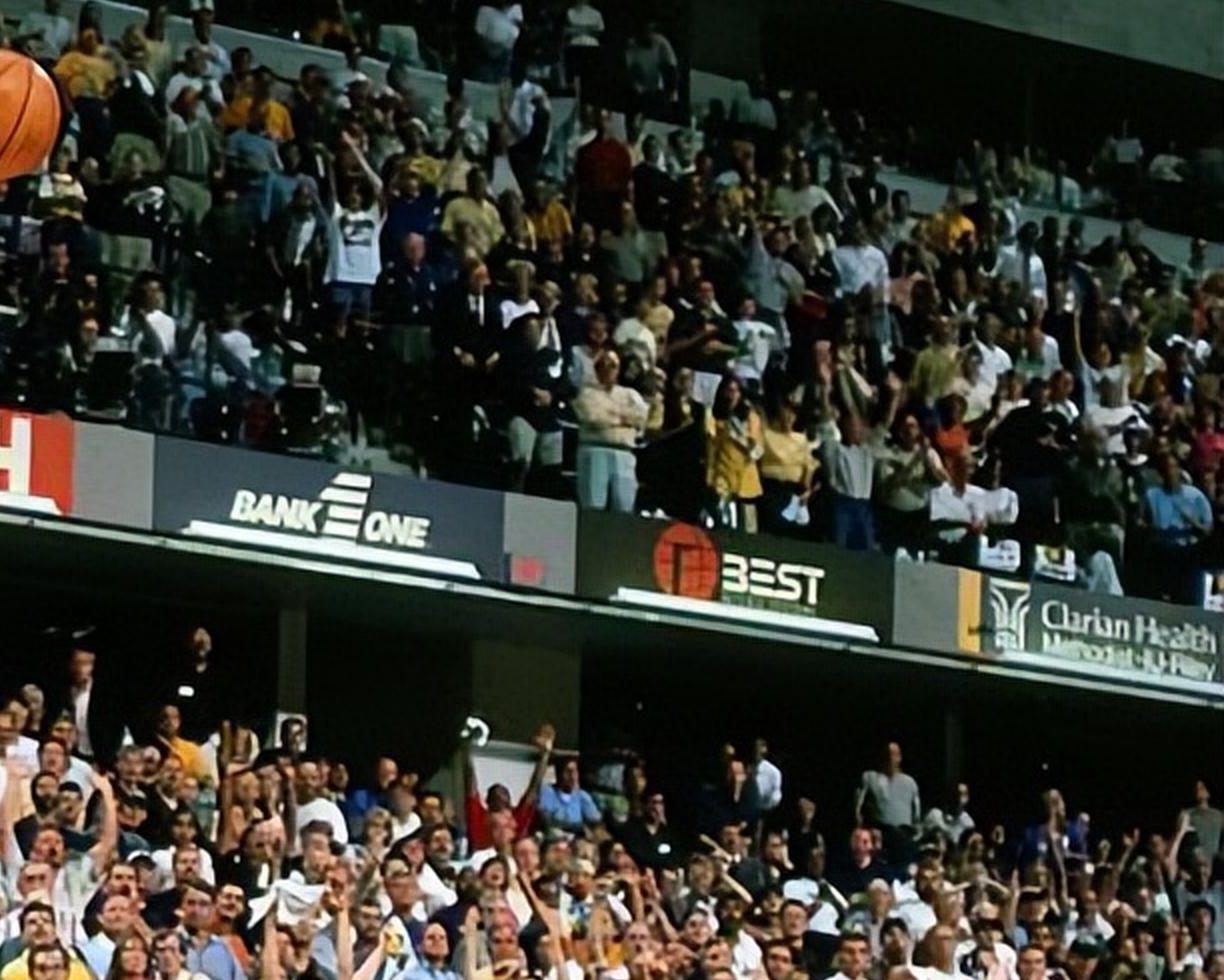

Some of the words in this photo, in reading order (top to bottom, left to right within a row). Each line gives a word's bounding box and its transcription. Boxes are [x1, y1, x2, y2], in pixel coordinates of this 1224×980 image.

[229, 489, 324, 533] BANK
[364, 511, 431, 548] ONE
[722, 552, 826, 606] BEST
[1042, 600, 1129, 641] Clarian
